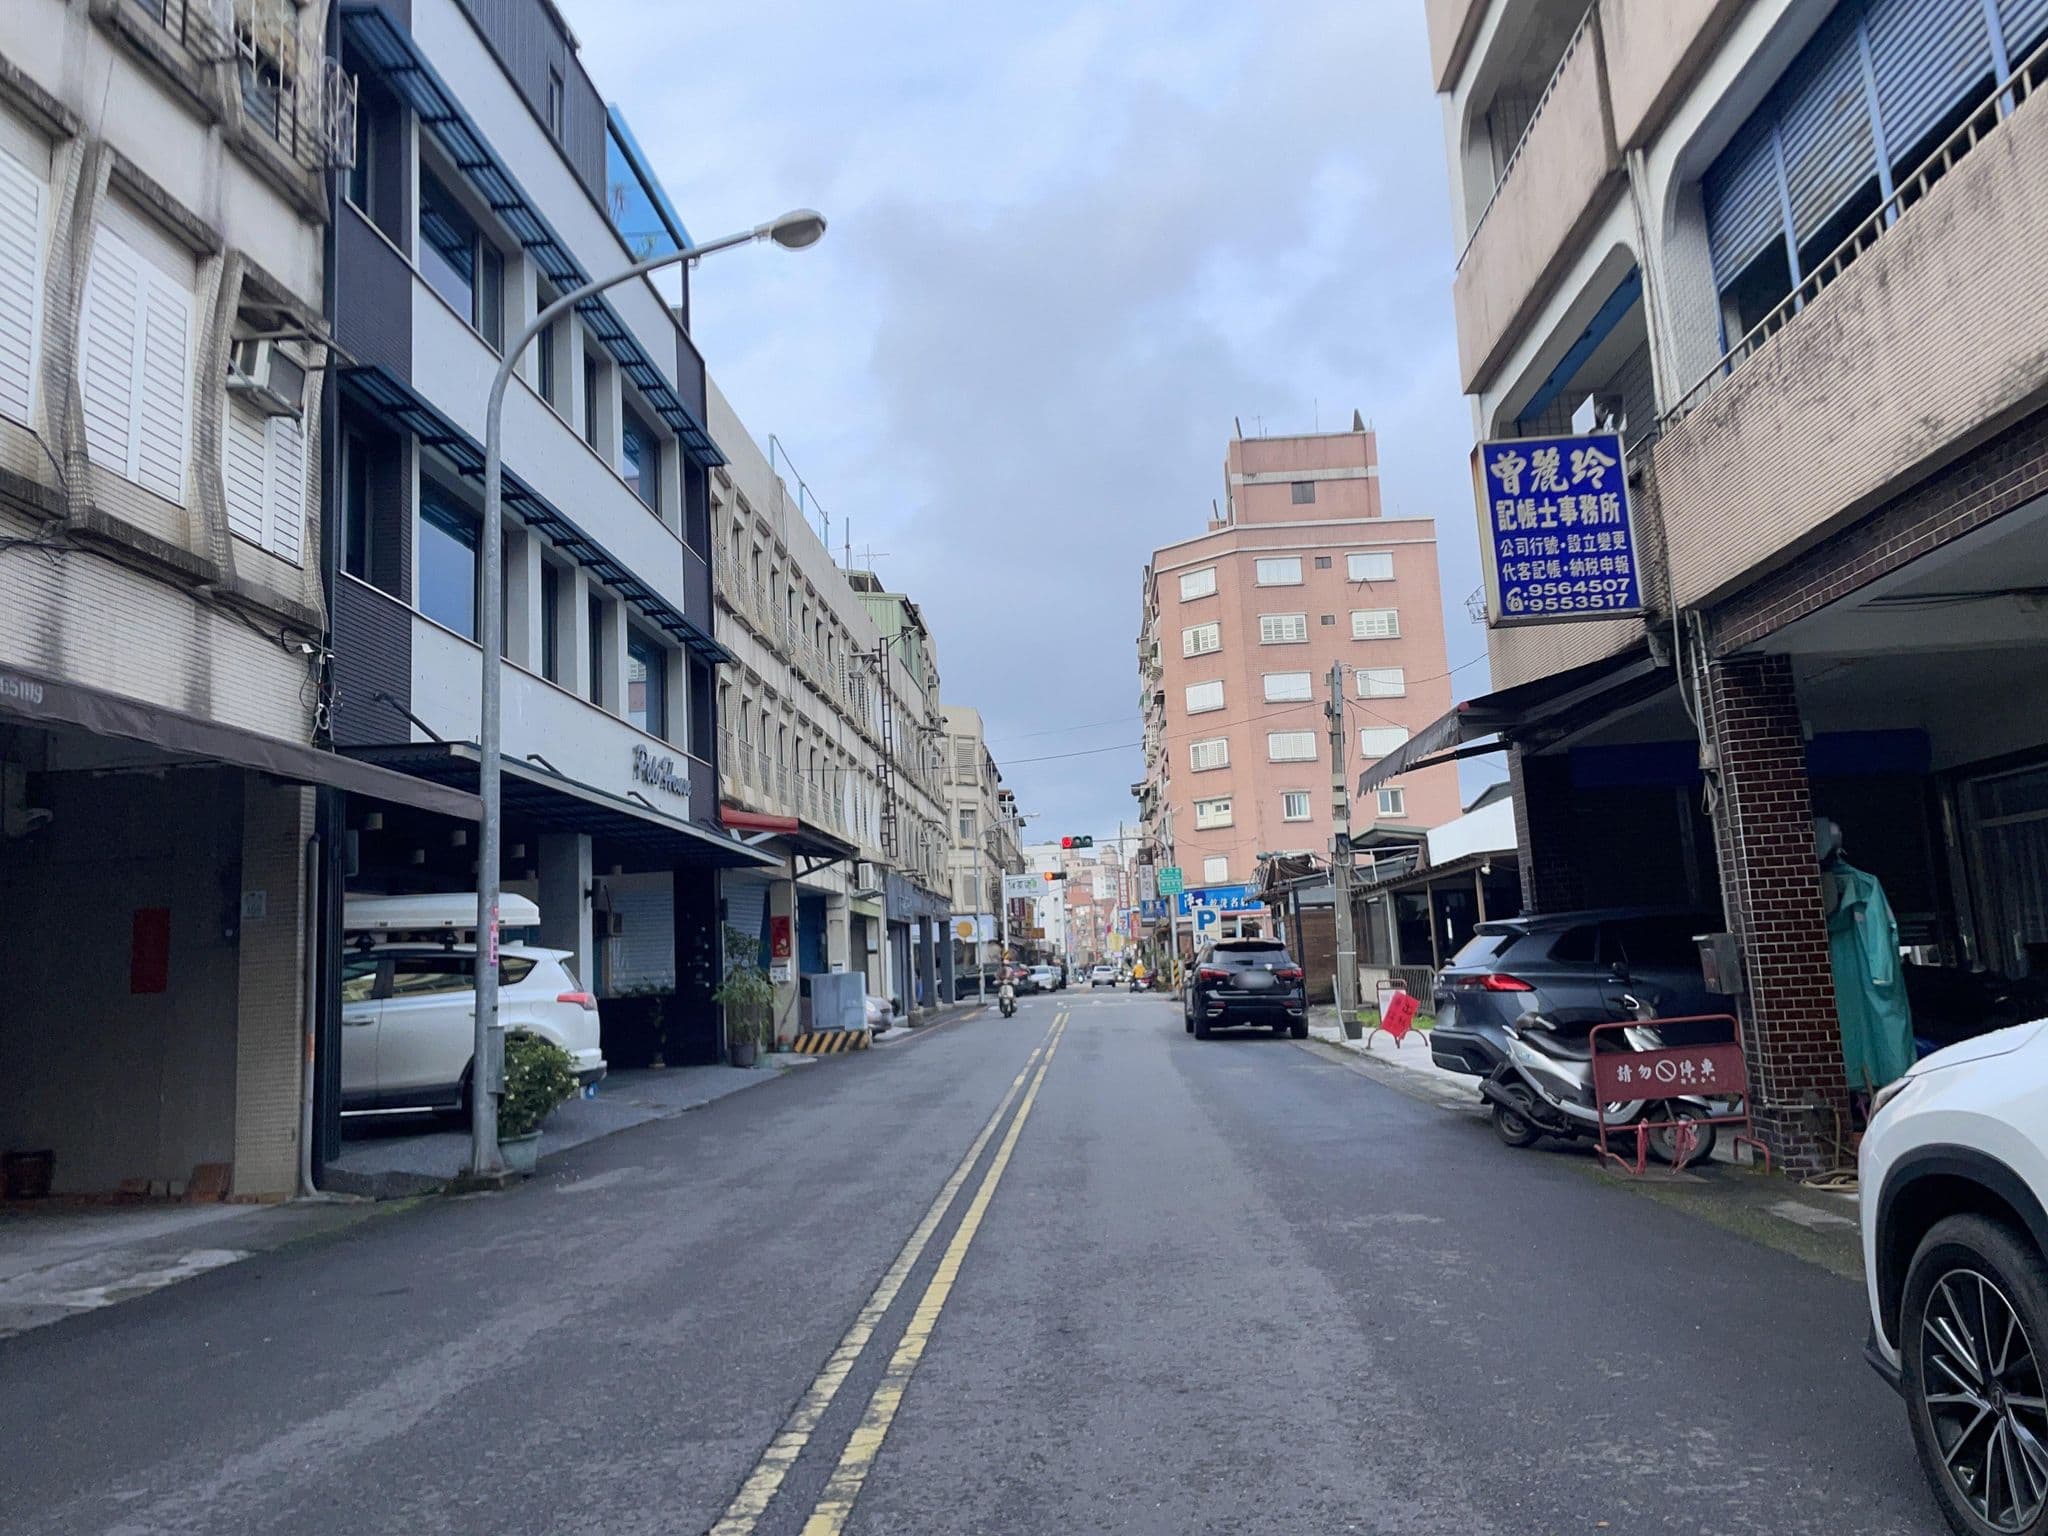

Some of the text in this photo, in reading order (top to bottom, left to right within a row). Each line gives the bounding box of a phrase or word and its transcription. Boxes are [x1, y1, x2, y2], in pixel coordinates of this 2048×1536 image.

[1491, 447, 1616, 496] 曾麗玲
[1496, 493, 1620, 531] 記帳士事務所
[1528, 578, 1630, 597] 9564507
[1529, 593, 1629, 611] 9553517
[1197, 909, 1217, 930] P
